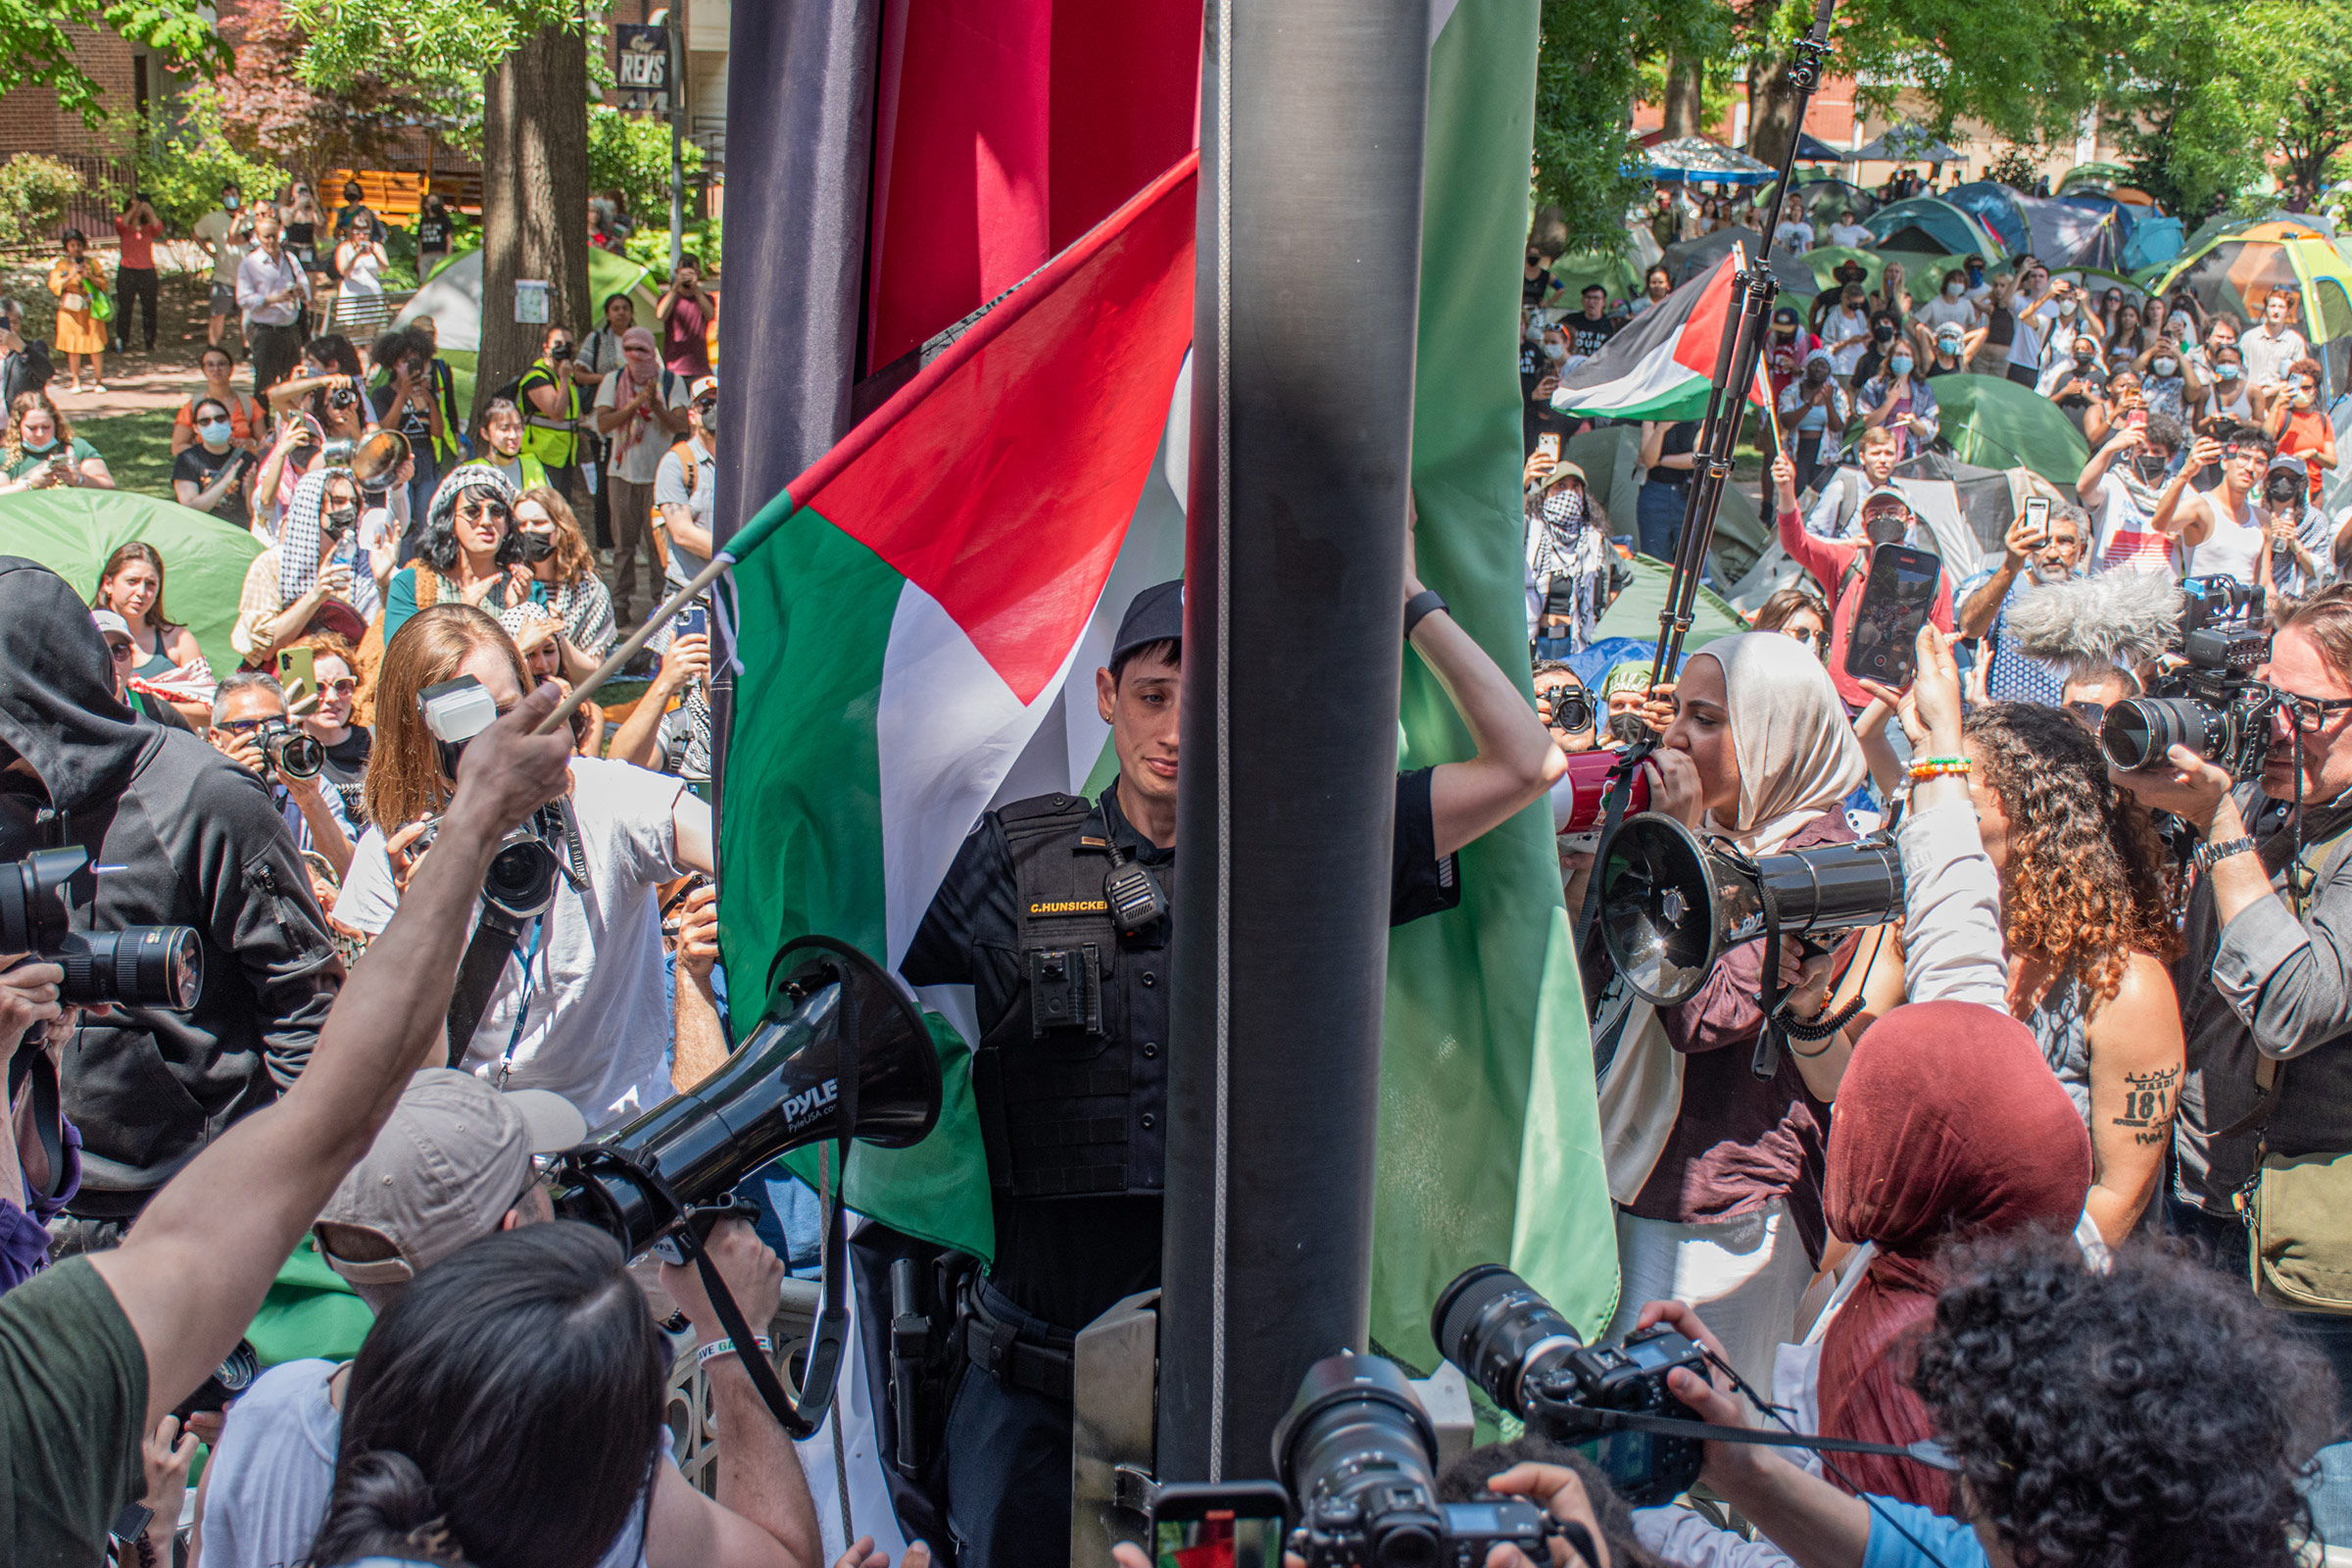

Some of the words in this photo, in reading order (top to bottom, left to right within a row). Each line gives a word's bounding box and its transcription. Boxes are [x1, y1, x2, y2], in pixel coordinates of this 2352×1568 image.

[619, 53, 666, 85] REVS
[2135, 1078, 2175, 1091] MARDI
[782, 1078, 838, 1123] PYLE
[2124, 1092, 2155, 1119] 18
